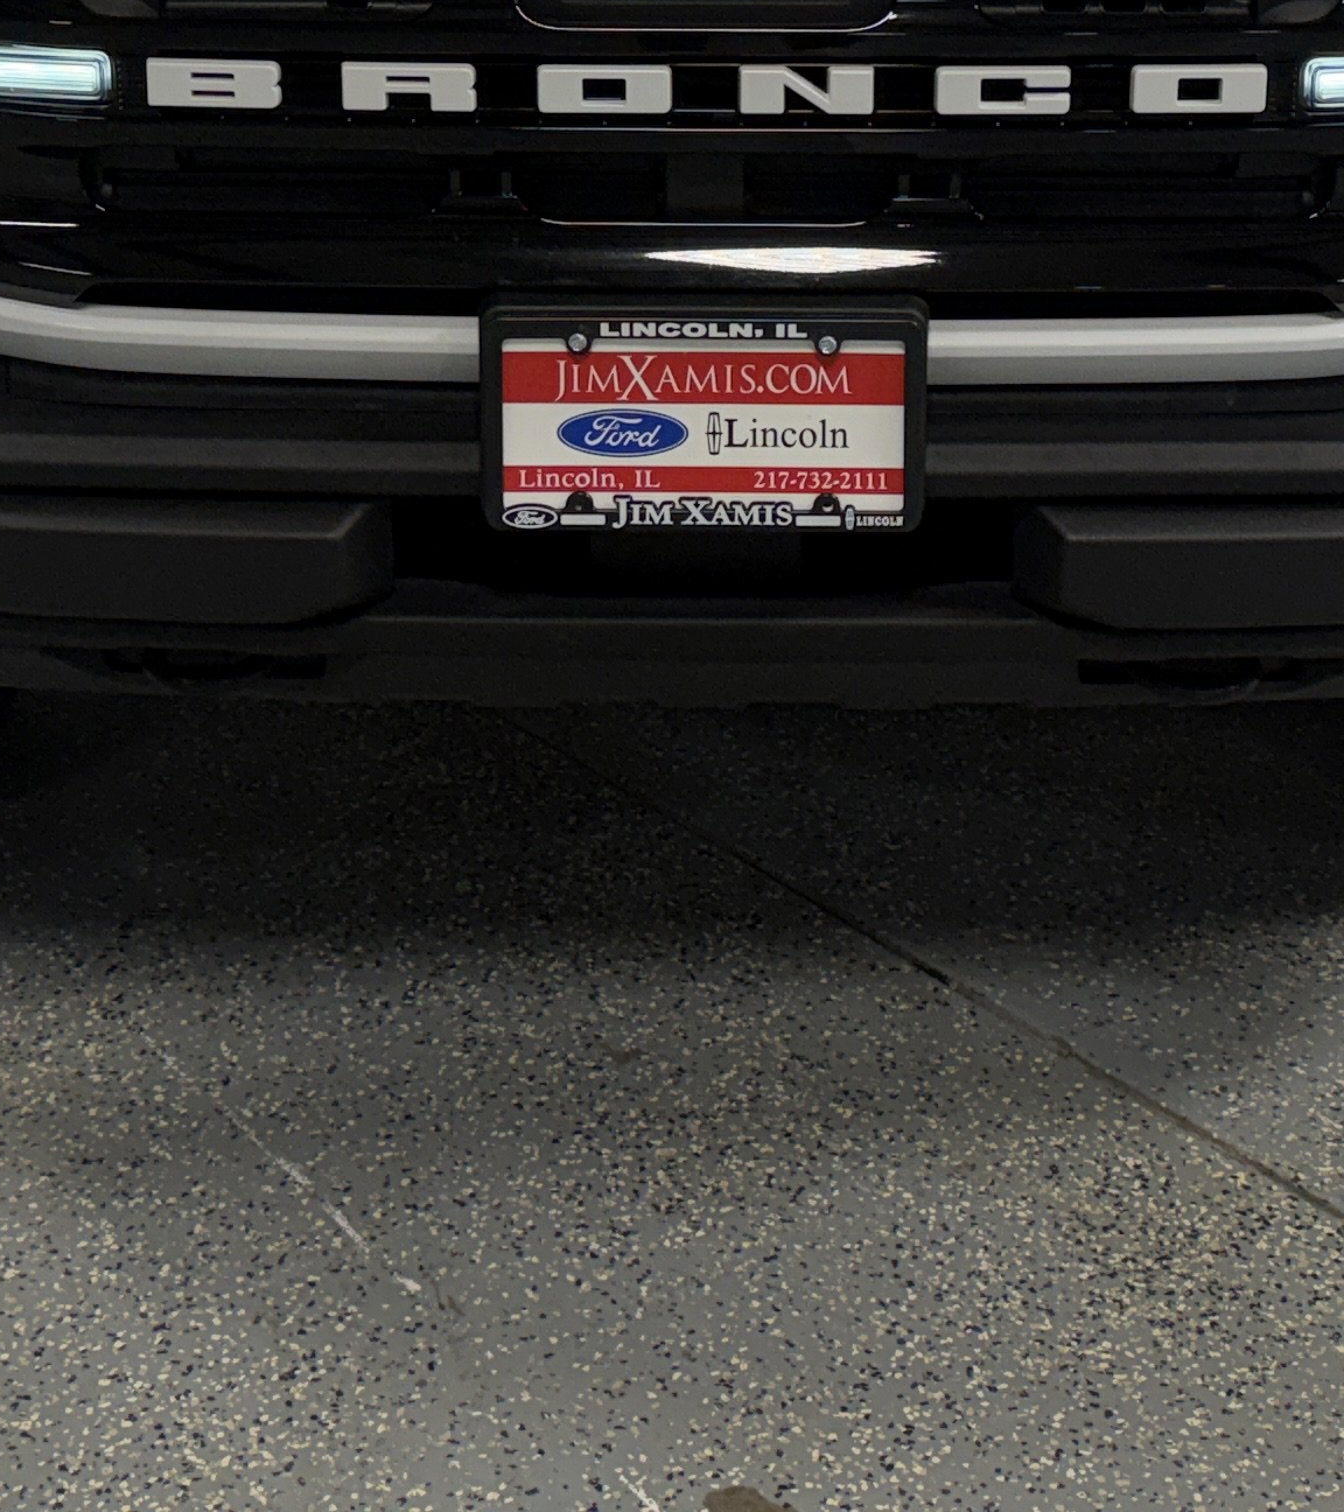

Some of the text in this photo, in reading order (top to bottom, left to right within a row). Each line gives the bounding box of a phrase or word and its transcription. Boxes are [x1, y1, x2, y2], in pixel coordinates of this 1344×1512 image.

[145, 57, 1268, 115] BRONCO
[599, 322, 808, 339] LINCOLN, IL
[555, 355, 852, 401] JIMXAMIS.COM
[583, 415, 662, 448] Ford
[723, 418, 849, 449] Lincoln
[519, 467, 661, 490] Lincoln, IL
[753, 471, 888, 490] 217-732-2111
[612, 496, 794, 529] JIM XAMIS
[855, 515, 904, 527] LINCOLN
